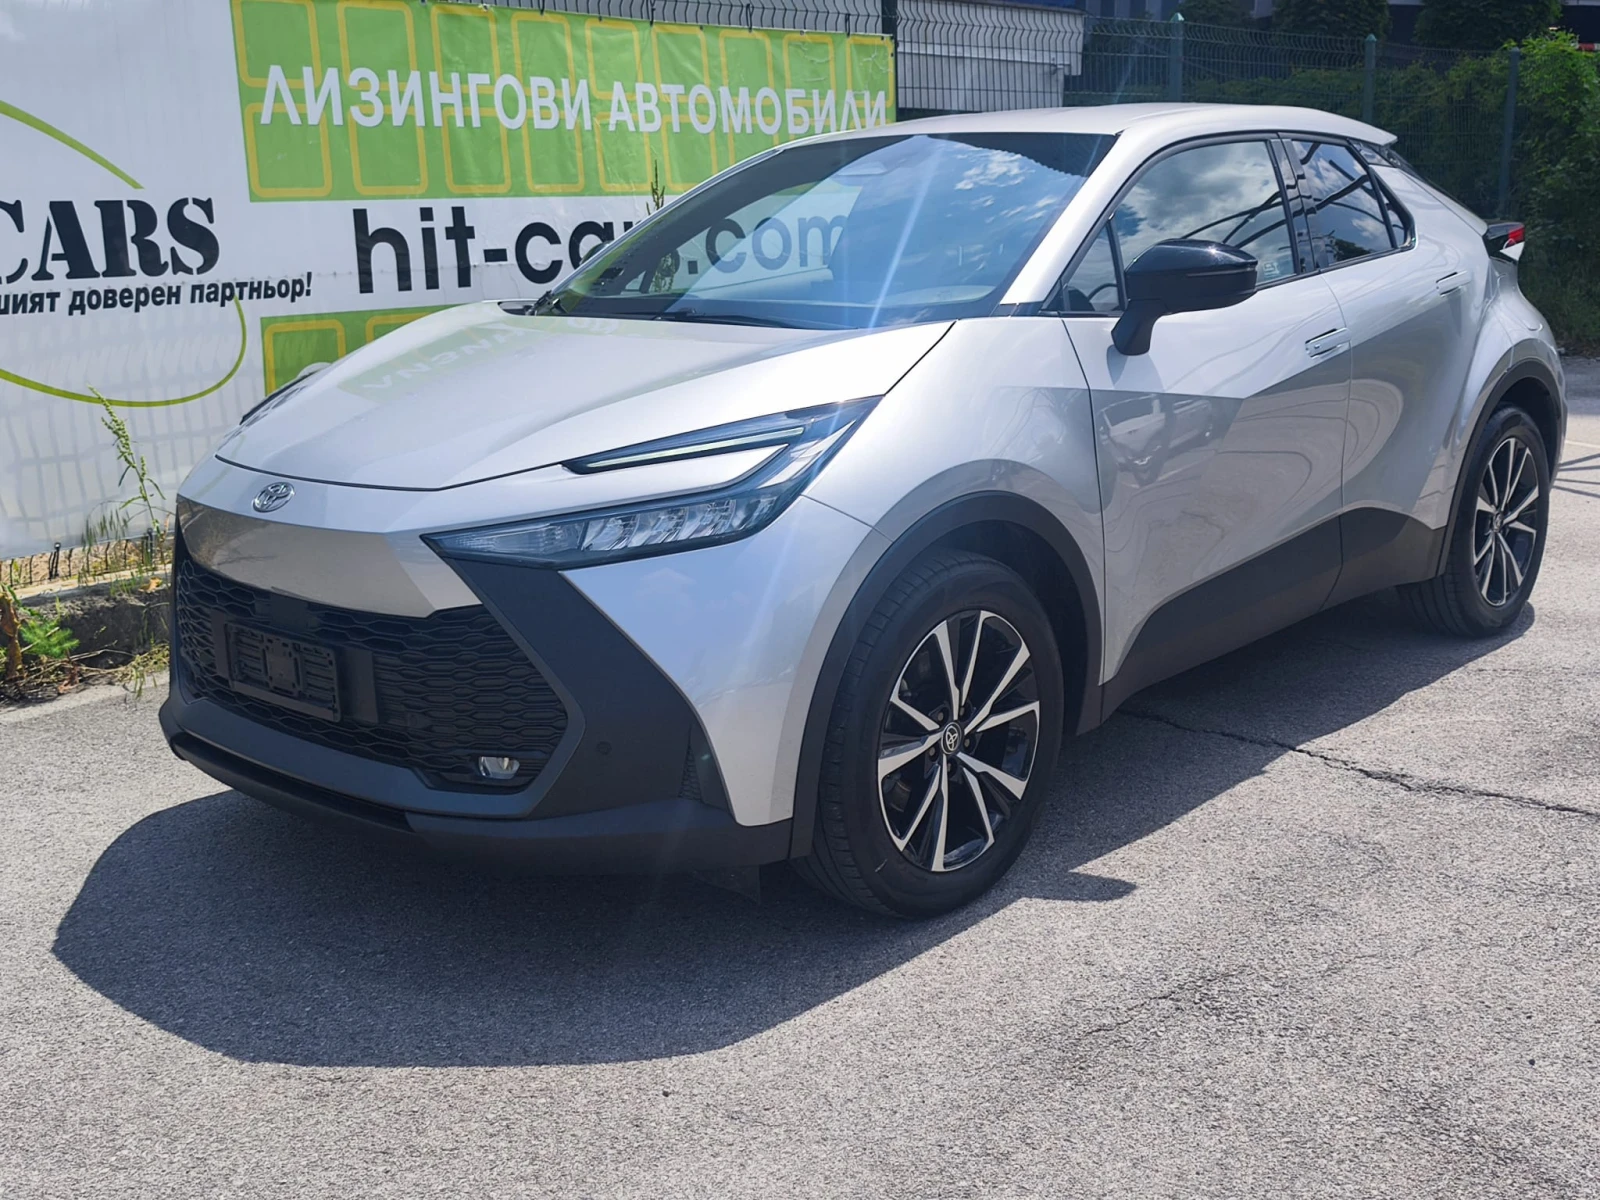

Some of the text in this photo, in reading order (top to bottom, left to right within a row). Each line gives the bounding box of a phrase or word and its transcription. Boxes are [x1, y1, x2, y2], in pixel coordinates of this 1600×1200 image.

[260, 65, 886, 135] ЛИЗИНГОВИ АВТОМОБИЛИ
[353, 206, 846, 294] hit-ca.com
[68, 282, 182, 316] доверен
[190, 272, 313, 308] партньор!
